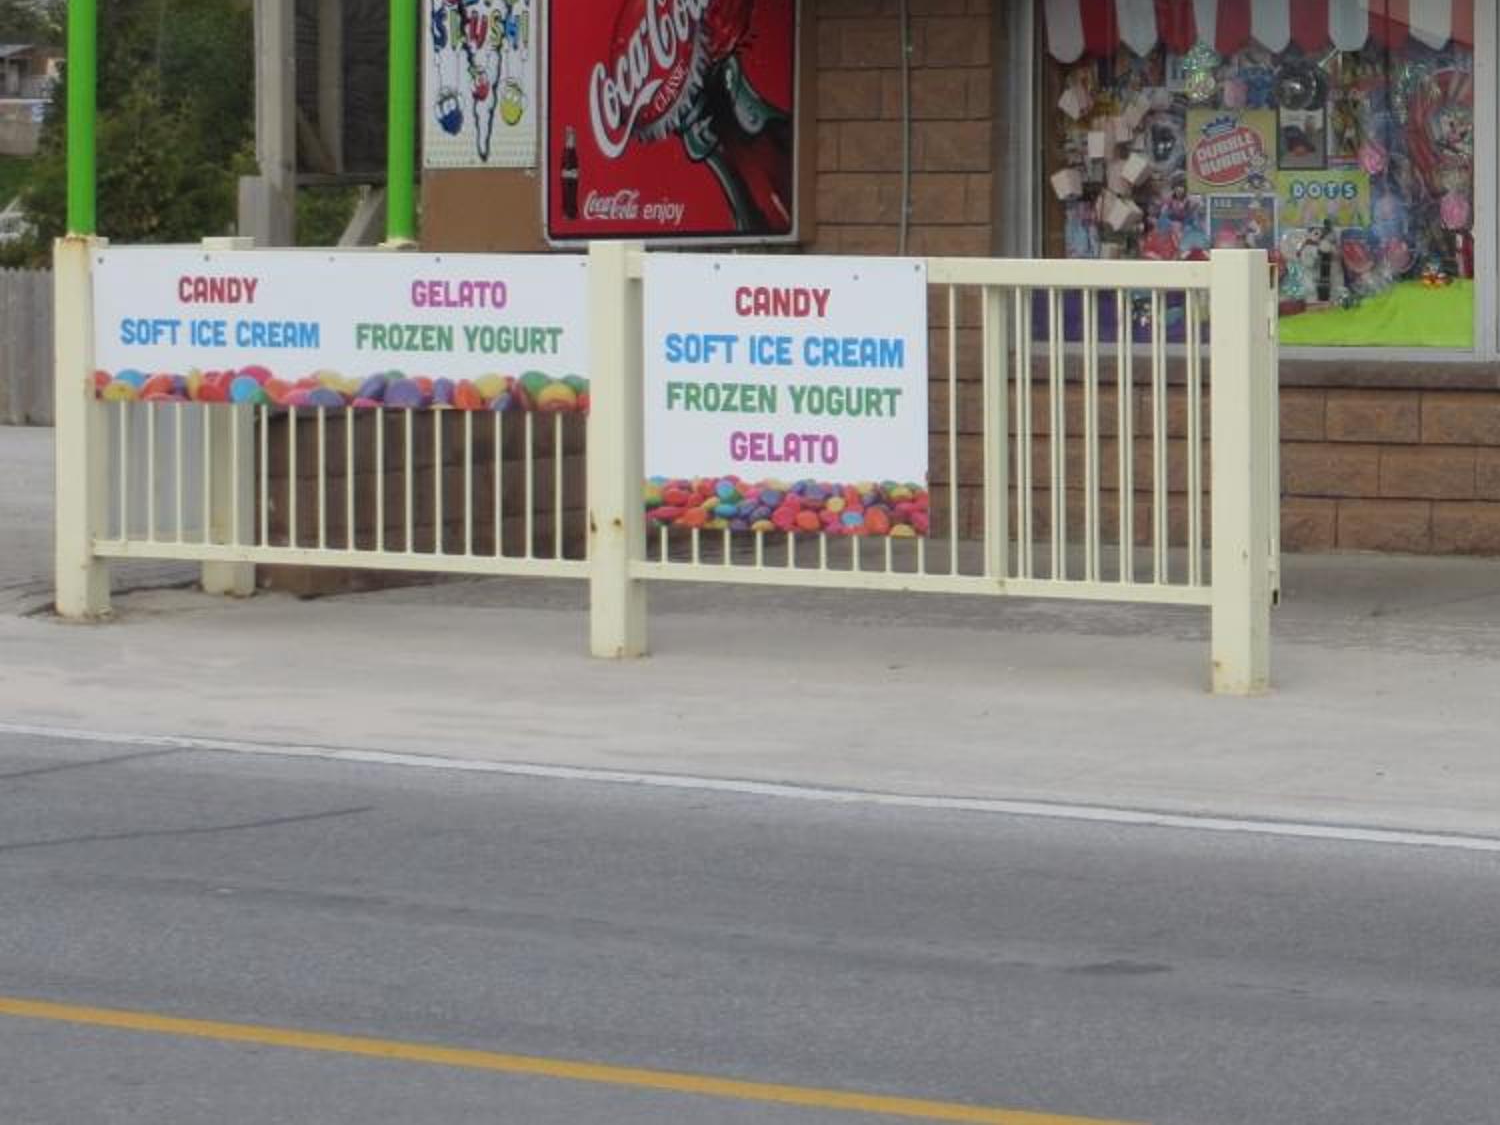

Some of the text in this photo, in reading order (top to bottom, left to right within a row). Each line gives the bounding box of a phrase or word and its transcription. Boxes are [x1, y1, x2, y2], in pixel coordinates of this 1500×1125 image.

[1292, 180, 1357, 200] DOTS
[642, 197, 685, 225] enjoy
[178, 276, 260, 304] CANDY
[411, 280, 507, 309] GELATO
[735, 286, 831, 318] CANDY
[120, 319, 321, 350] SOFT ICE CREAM
[355, 323, 564, 355] FROZEN YOGURT
[665, 333, 905, 369] SOFT ICE CREAM
[667, 381, 903, 418] FROZEN YOGURT
[729, 431, 839, 465] GELATO
